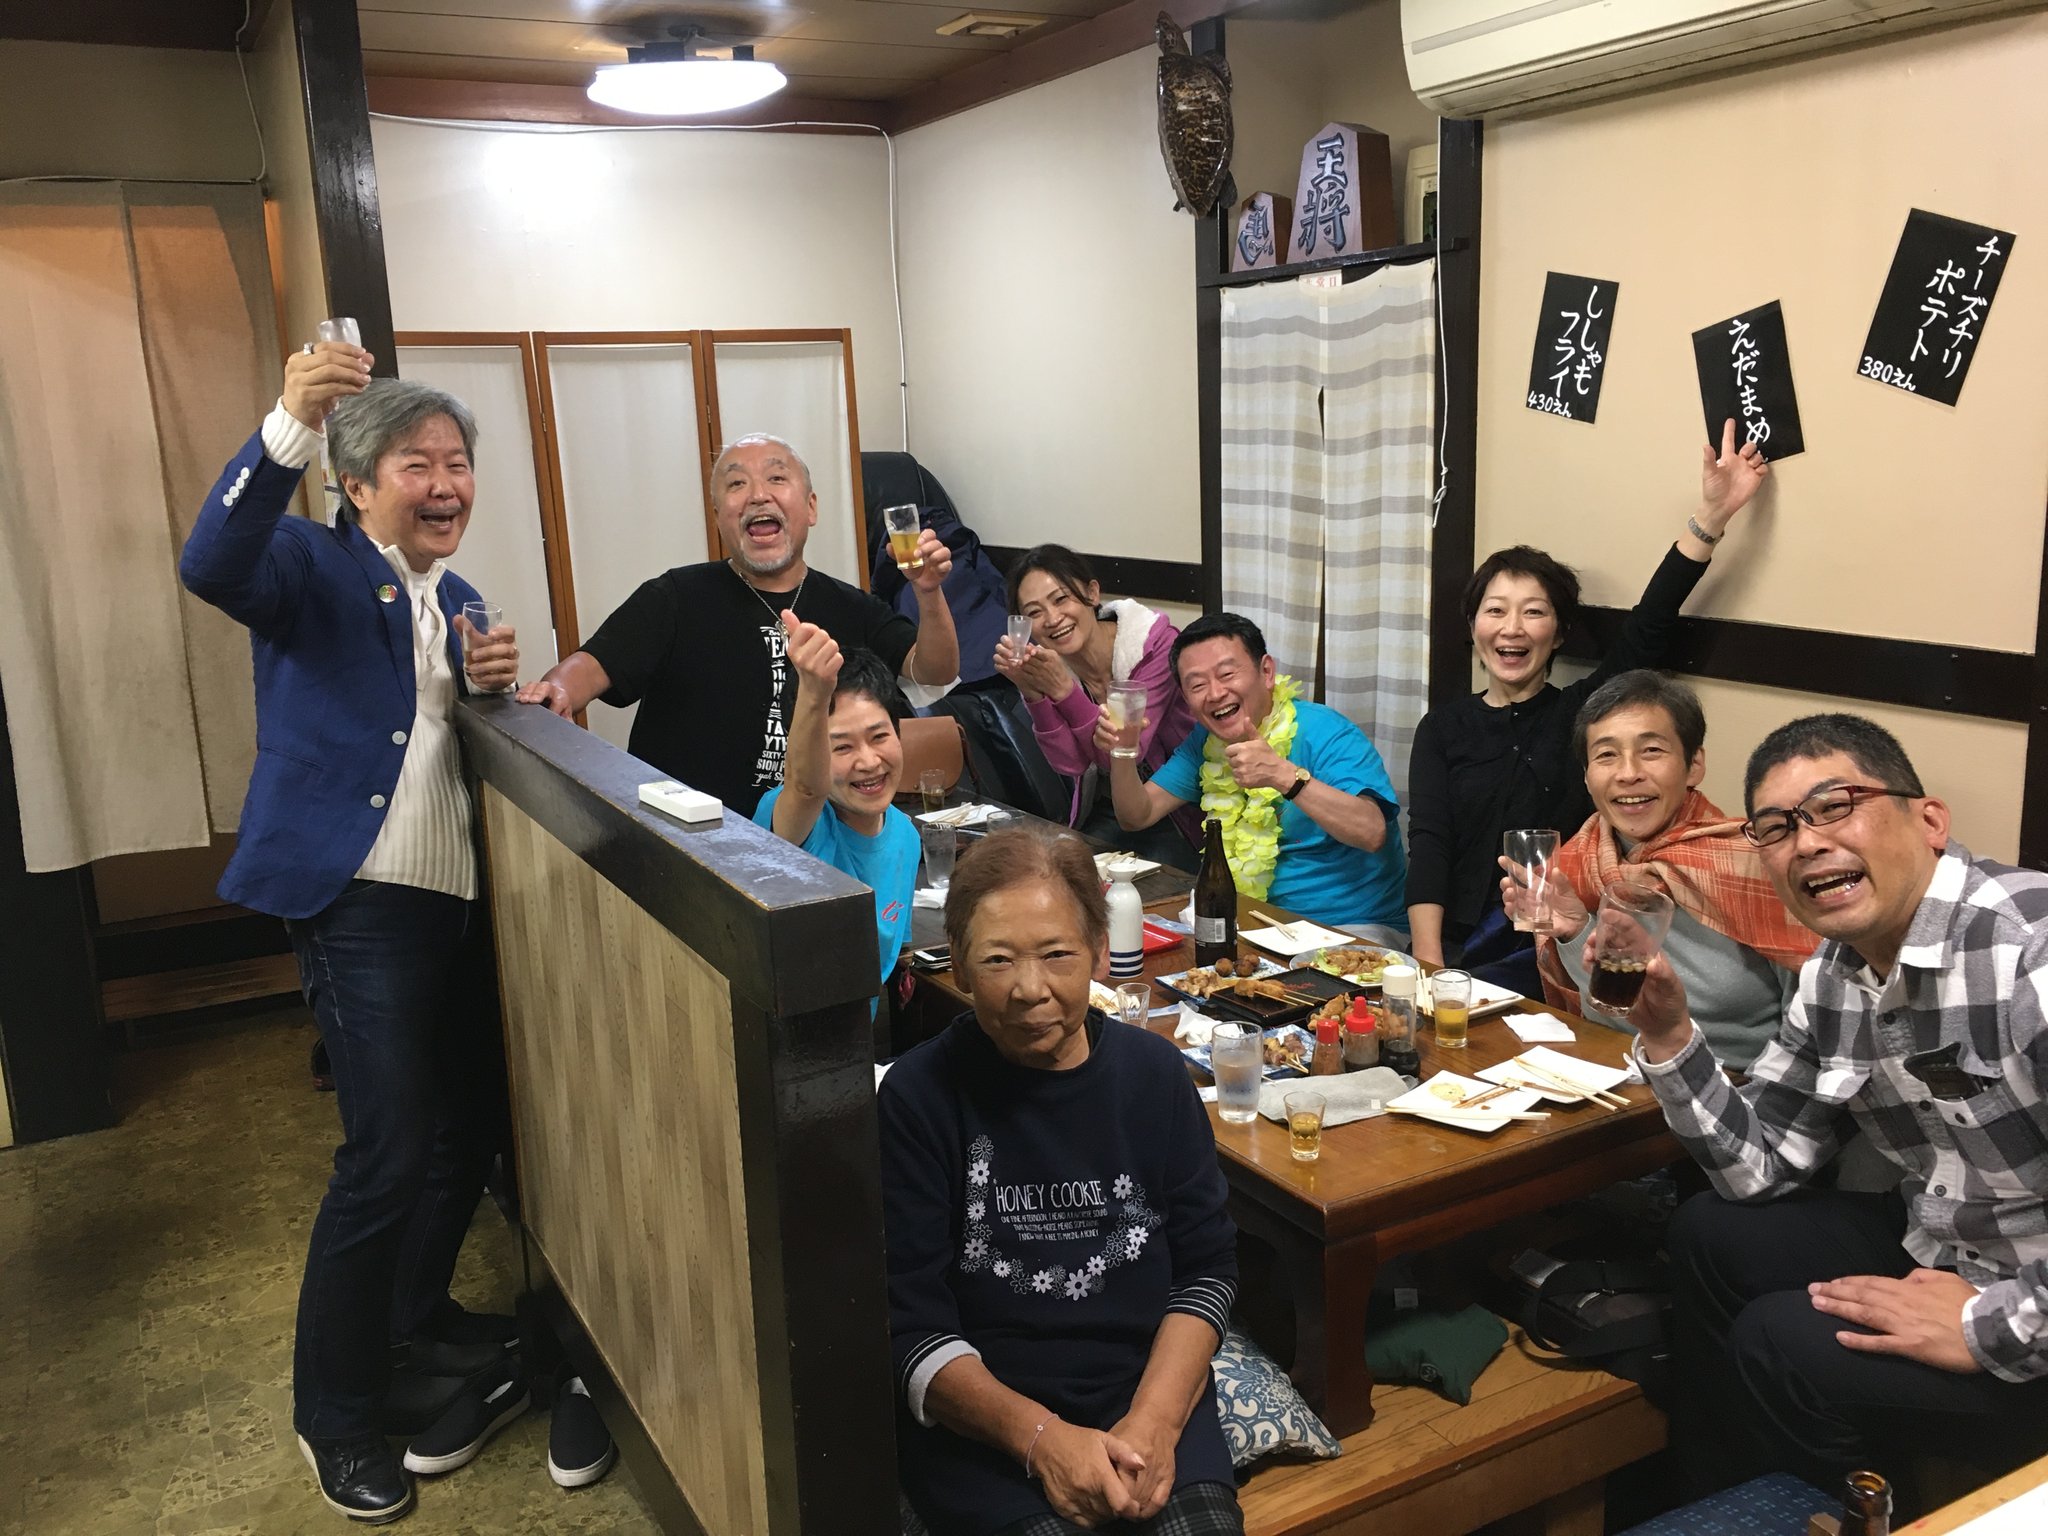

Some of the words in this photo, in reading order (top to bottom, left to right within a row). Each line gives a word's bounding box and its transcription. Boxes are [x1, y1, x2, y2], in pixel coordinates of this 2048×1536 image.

[1297, 131, 1351, 257] 王将
[1548, 310, 1581, 398] フライ
[1573, 284, 1603, 395] ししゃも
[1909, 258, 1966, 362] ポテト
[1944, 235, 2001, 379] チーズチリ
[1527, 390, 1572, 418] 430えん
[1728, 319, 1771, 446] えだまめ
[1860, 355, 1916, 392] 380えん
[995, 1183, 1045, 1213] HONEY
